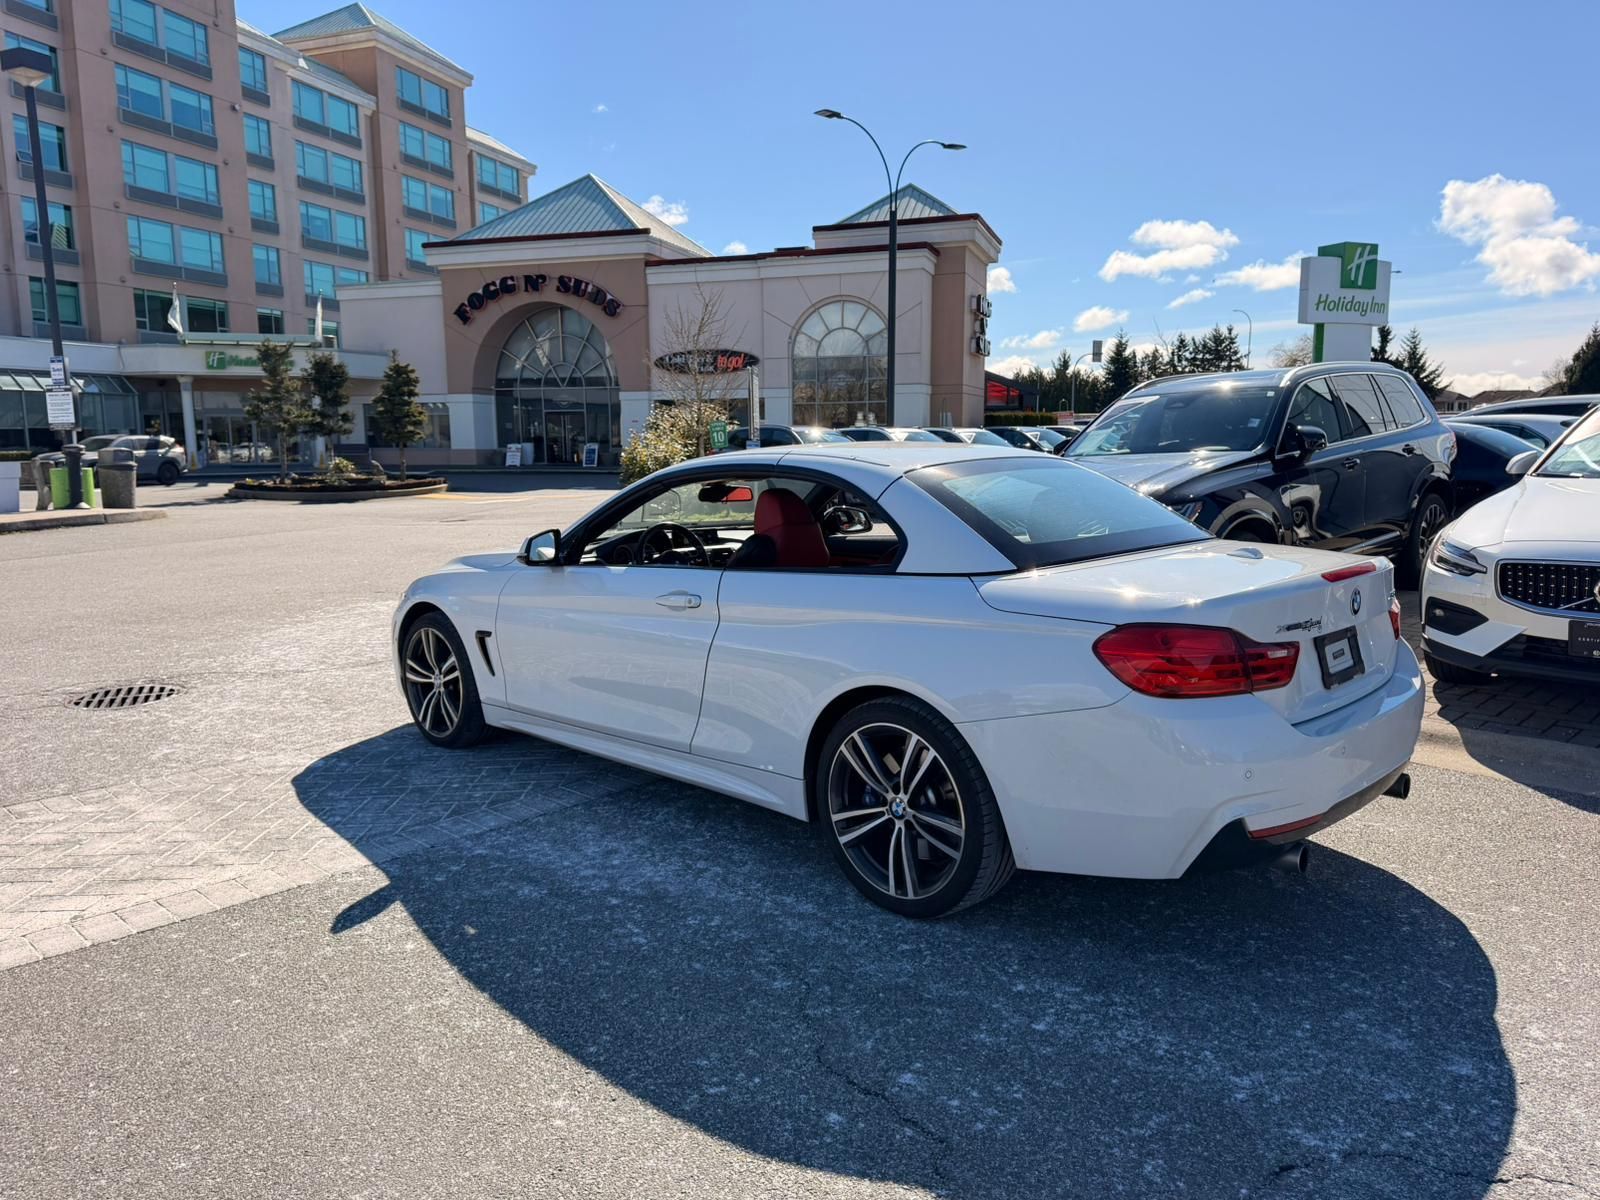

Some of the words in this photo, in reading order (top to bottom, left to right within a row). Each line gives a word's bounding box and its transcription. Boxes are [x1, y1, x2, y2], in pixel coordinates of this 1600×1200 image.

[556, 274, 624, 317] SUDS
[1315, 294, 1369, 316] Holiday
[1369, 295, 1386, 314] Inn
[716, 354, 727, 368] to
[727, 352, 745, 372] go!
[712, 431, 725, 442] 10
